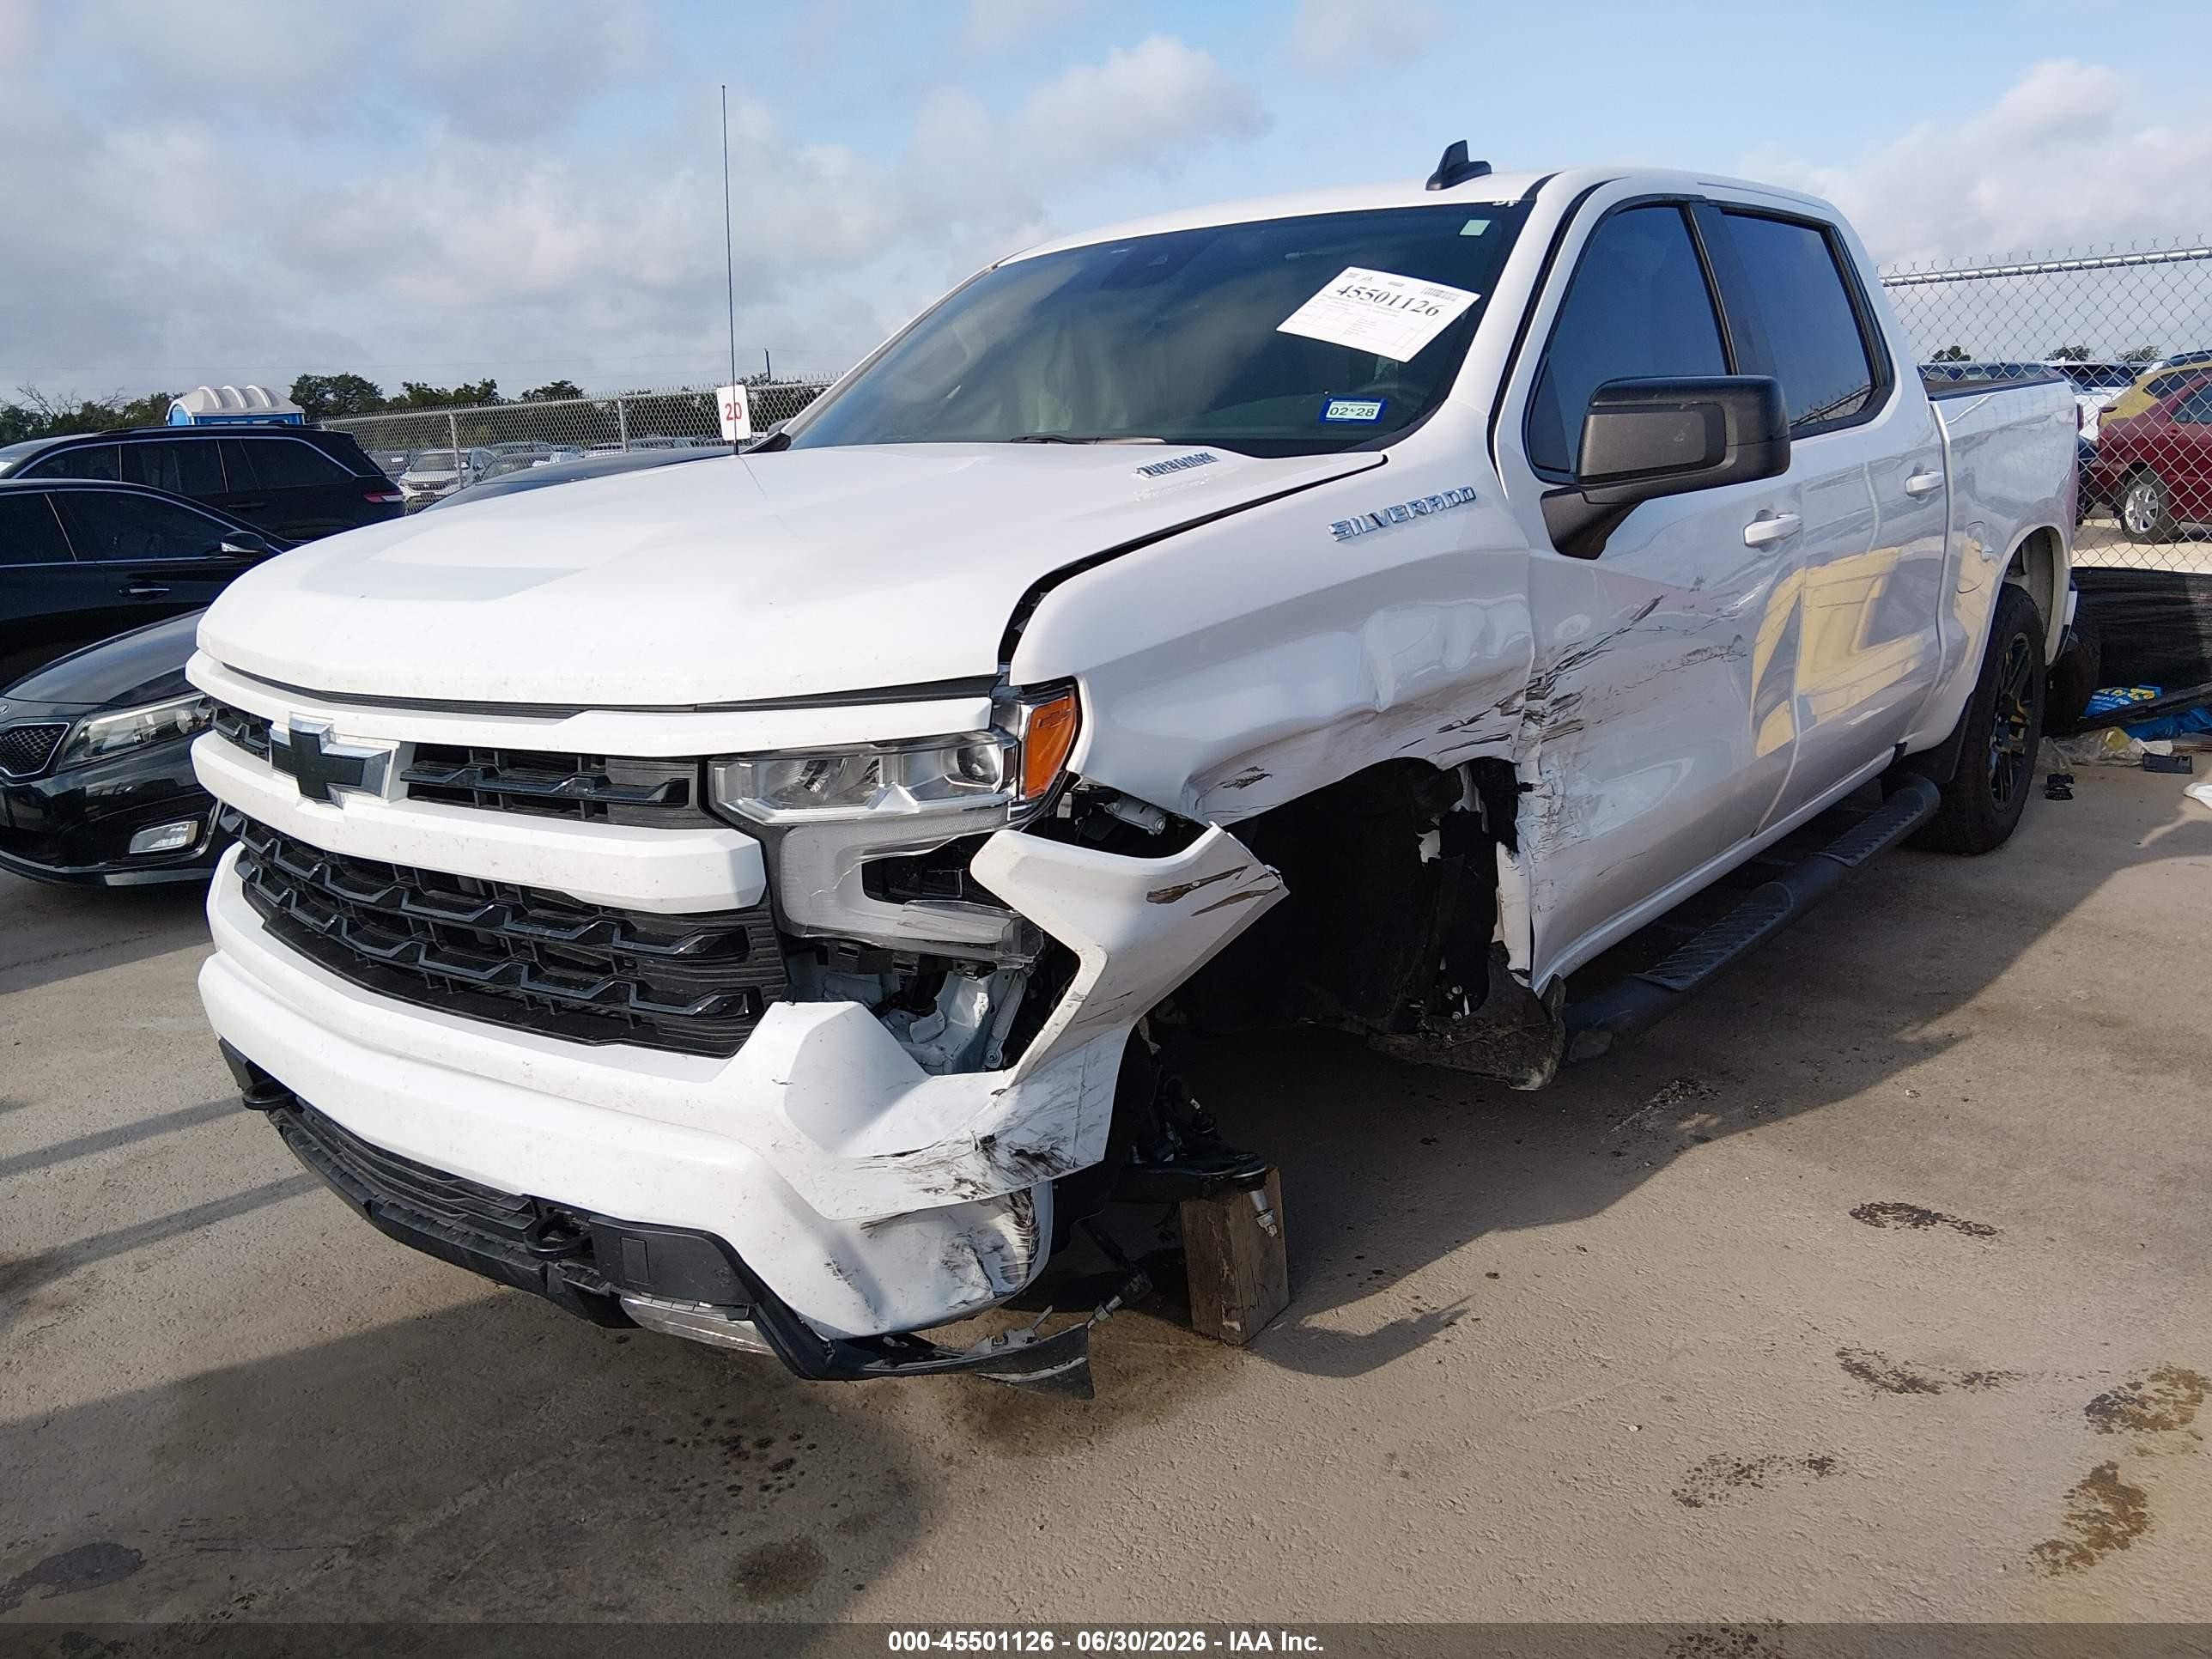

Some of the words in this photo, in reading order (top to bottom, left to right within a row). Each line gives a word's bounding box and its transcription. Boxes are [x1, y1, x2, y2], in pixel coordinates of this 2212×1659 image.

[1336, 284, 1445, 317] 45501126
[725, 402, 742, 421] 20
[1328, 486, 1476, 542] SILVERADO
